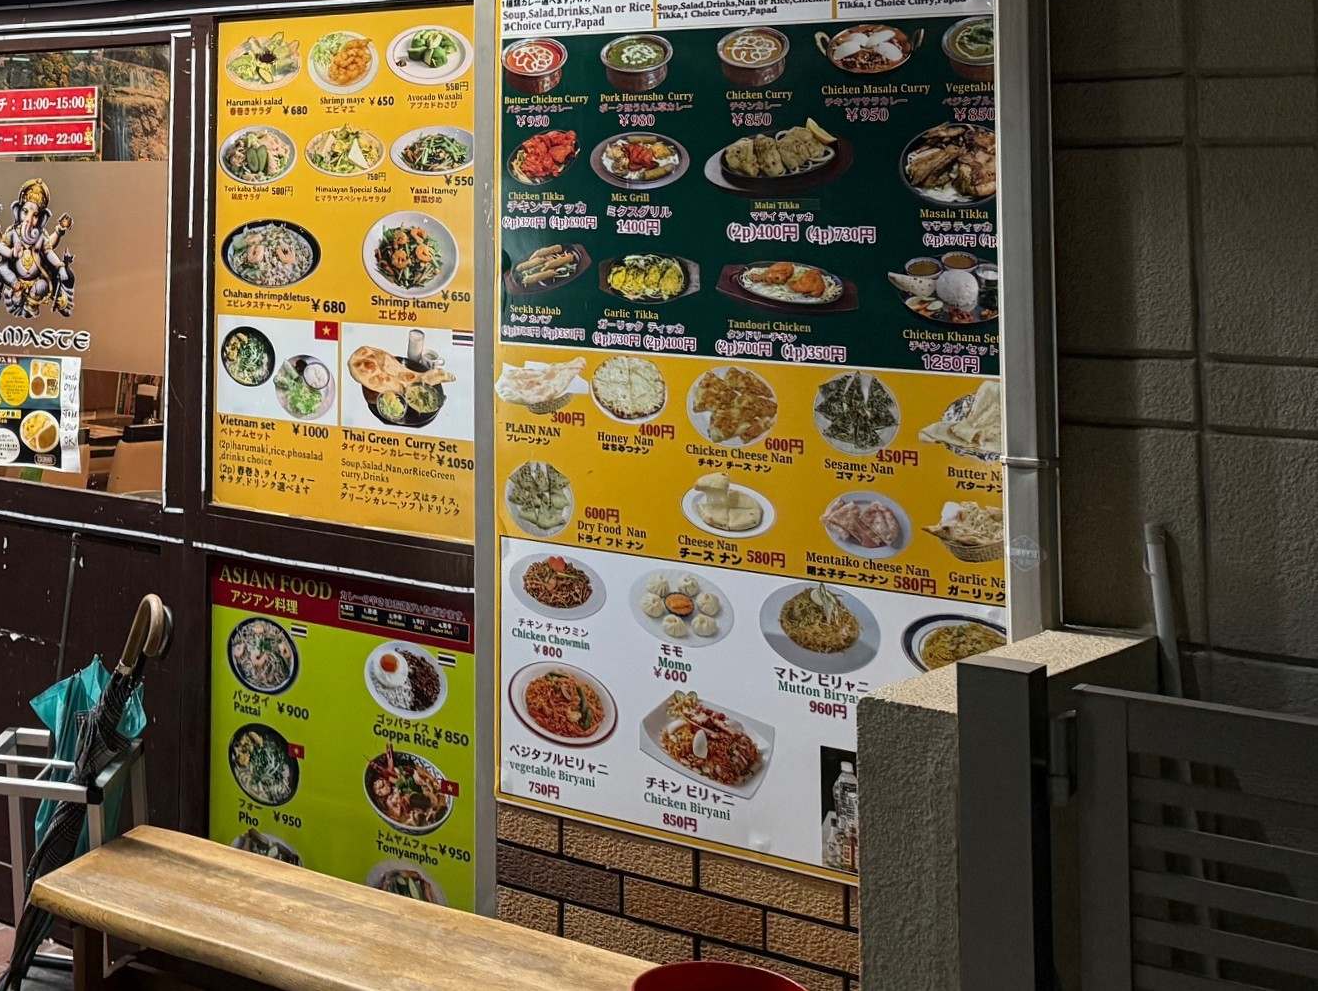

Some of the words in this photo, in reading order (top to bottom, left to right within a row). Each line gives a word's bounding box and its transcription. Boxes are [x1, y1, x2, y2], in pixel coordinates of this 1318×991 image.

[691, 8, 720, 18] Choice
[668, 92, 693, 101] Curry
[726, 91, 763, 100] Chicken
[765, 90, 792, 101] Curry
[821, 85, 860, 95] Chicken
[863, 84, 897, 94] Masala
[901, 83, 930, 95] Curry
[320, 97, 344, 105] Shrimp
[505, 96, 528, 104] Butter
[532, 95, 562, 104] Chicken
[565, 95, 588, 104] Curry
[57, 132, 82, 144] 22:00
[509, 192, 539, 200] Chicken
[542, 192, 564, 200] Tikka
[630, 193, 650, 202] Grill
[920, 209, 956, 219] Masala
[958, 210, 988, 219] Tikka
[371, 296, 410, 309] Shrimp
[412, 298, 450, 311] itamey
[604, 309, 630, 318] Garlic
[634, 310, 659, 319] Tikka
[728, 319, 771, 330] Tandoori
[773, 322, 811, 333] Chicken
[903, 330, 944, 340] Chicken
[947, 331, 981, 342] Khana
[220, 415, 258, 428] Vietnam
[260, 421, 275, 430] set
[551, 412, 585, 426] 300円
[221, 428, 271, 440] ベトナムセット
[292, 424, 329, 439] ¥1000
[506, 423, 536, 434] PLAIN
[538, 425, 561, 437] NAN
[639, 424, 674, 439] 400円
[342, 430, 365, 442] Thai
[368, 433, 399, 446] Green
[406, 438, 436, 453] Curry
[439, 441, 457, 453] Set
[598, 432, 628, 443] Honey
[634, 435, 654, 446] Nan
[765, 438, 804, 454] 600円
[436, 454, 474, 470] ¥1050
[686, 444, 728, 457] Chicken
[730, 449, 768, 462] Cheese
[770, 453, 793, 464] Nan
[876, 450, 918, 466] 450円
[825, 459, 868, 472] Sesame
[871, 464, 894, 475] Nan
[948, 467, 986, 480] Butter
[585, 506, 620, 523] 600円
[578, 521, 595, 535] Dry
[597, 523, 621, 535] Food
[627, 527, 646, 538] Nan
[578, 533, 601, 544] ドライ
[678, 535, 714, 549] Cheese
[717, 540, 738, 552] Nan
[680, 548, 714, 562] チーズ
[720, 552, 742, 565] ナン
[747, 550, 786, 568] 580円
[806, 551, 859, 569] Mentaiko
[863, 561, 903, 574] cheese
[906, 565, 929, 577] Nan
[219, 564, 276, 590] ASIAN
[280, 575, 332, 600] FOOD
[894, 576, 936, 594] 580円
[949, 572, 988, 586] Garlic
[231, 590, 298, 614] アジアン料理
[518, 618, 544, 629] チキン
[545, 623, 589, 637] チャウミン
[512, 628, 546, 641] Chicken
[548, 633, 590, 650] Chowmin
[660, 644, 683, 657] モモ
[658, 657, 692, 672] Momo
[774, 667, 812, 683] マトン
[778, 680, 820, 698] Mutton
[233, 690, 270, 706] パッタイ
[809, 701, 847, 719] 960円
[373, 725, 411, 743] Goppa
[414, 731, 439, 749] Rice
[433, 726, 469, 747] ¥850
[558, 770, 595, 788] Biryani
[529, 781, 560, 800] 750円
[646, 777, 681, 792] チキン
[686, 785, 735, 806] ビリャニ
[644, 793, 686, 810] Chicken
[690, 802, 730, 821] Biryani
[239, 812, 259, 826] Pho
[663, 812, 697, 832] 850円
[376, 841, 439, 866] Tomyampho
[439, 837, 471, 862] ¥950
